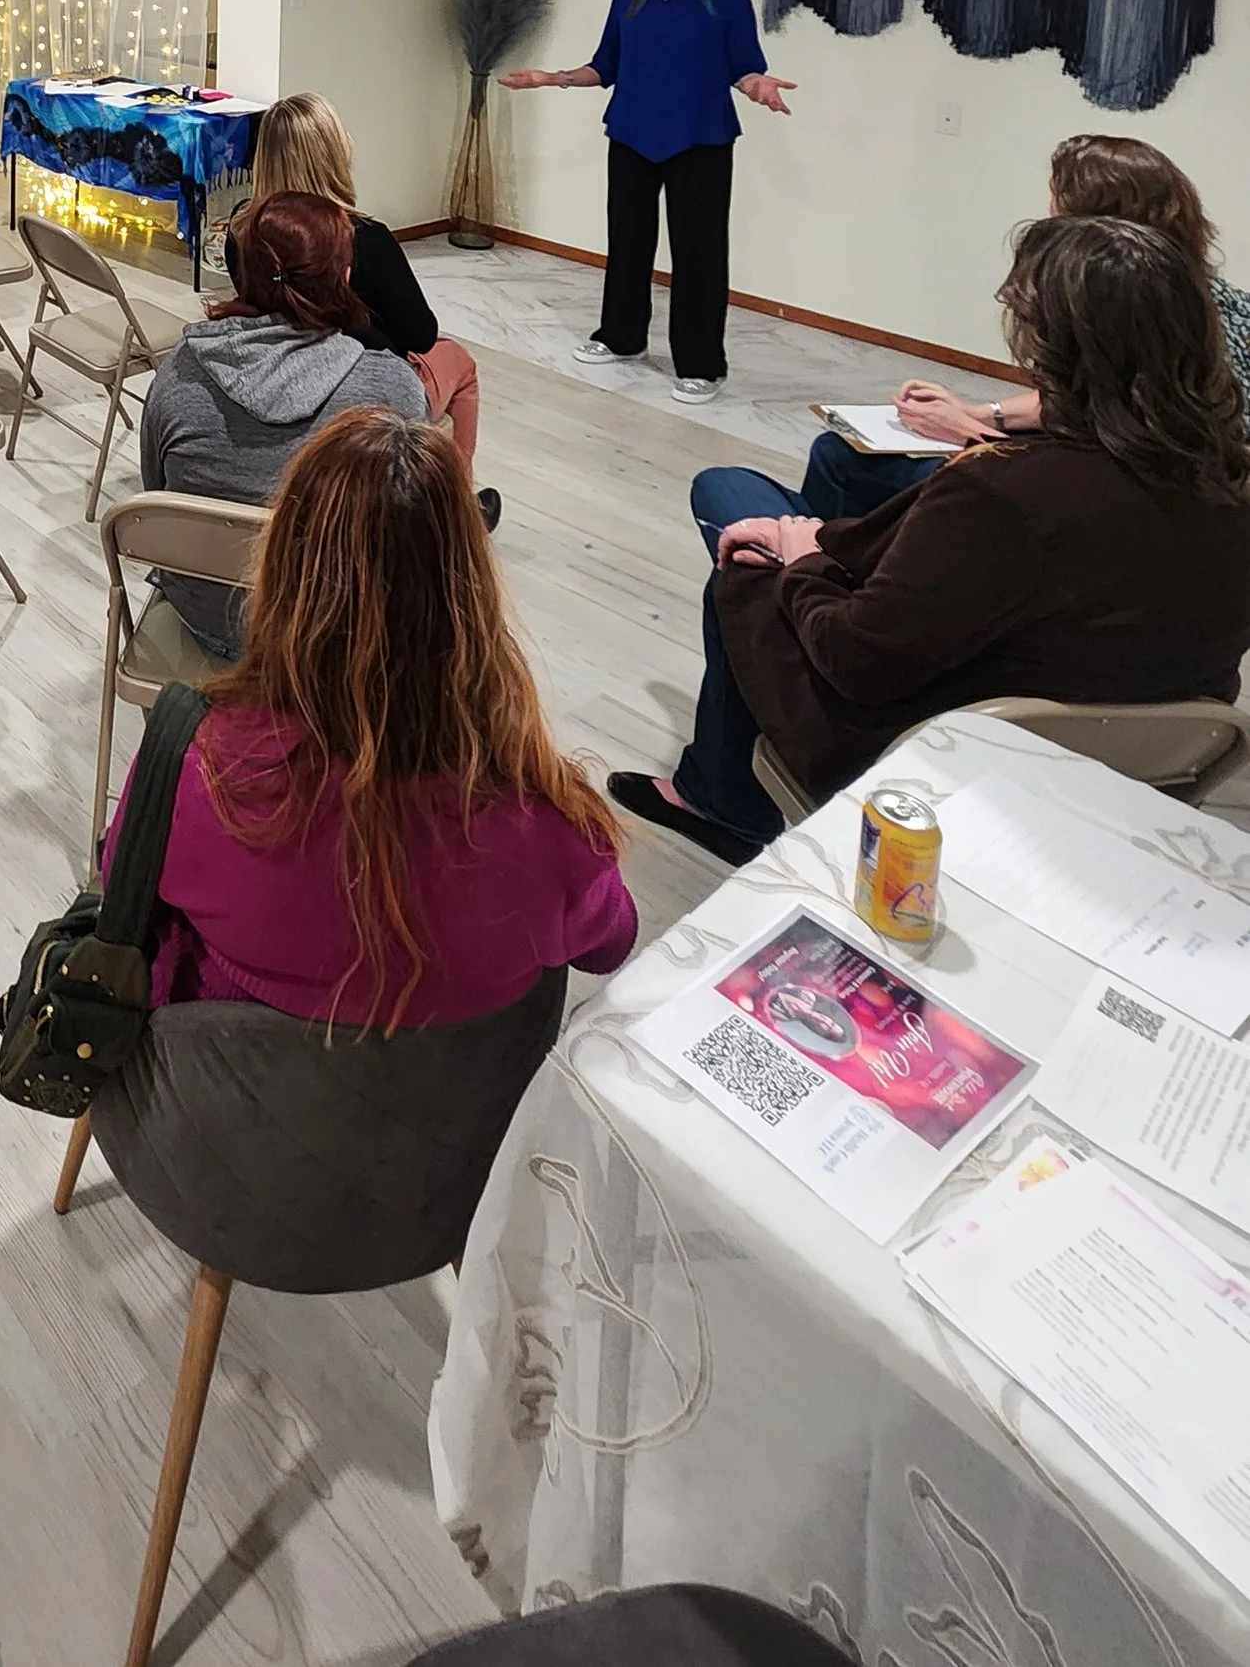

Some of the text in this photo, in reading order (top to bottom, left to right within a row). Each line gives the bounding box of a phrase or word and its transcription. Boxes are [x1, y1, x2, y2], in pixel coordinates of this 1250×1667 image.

[757, 946, 800, 983] Register Today!
[895, 1011, 934, 1054] Join
[868, 1049, 911, 1089] Us!
